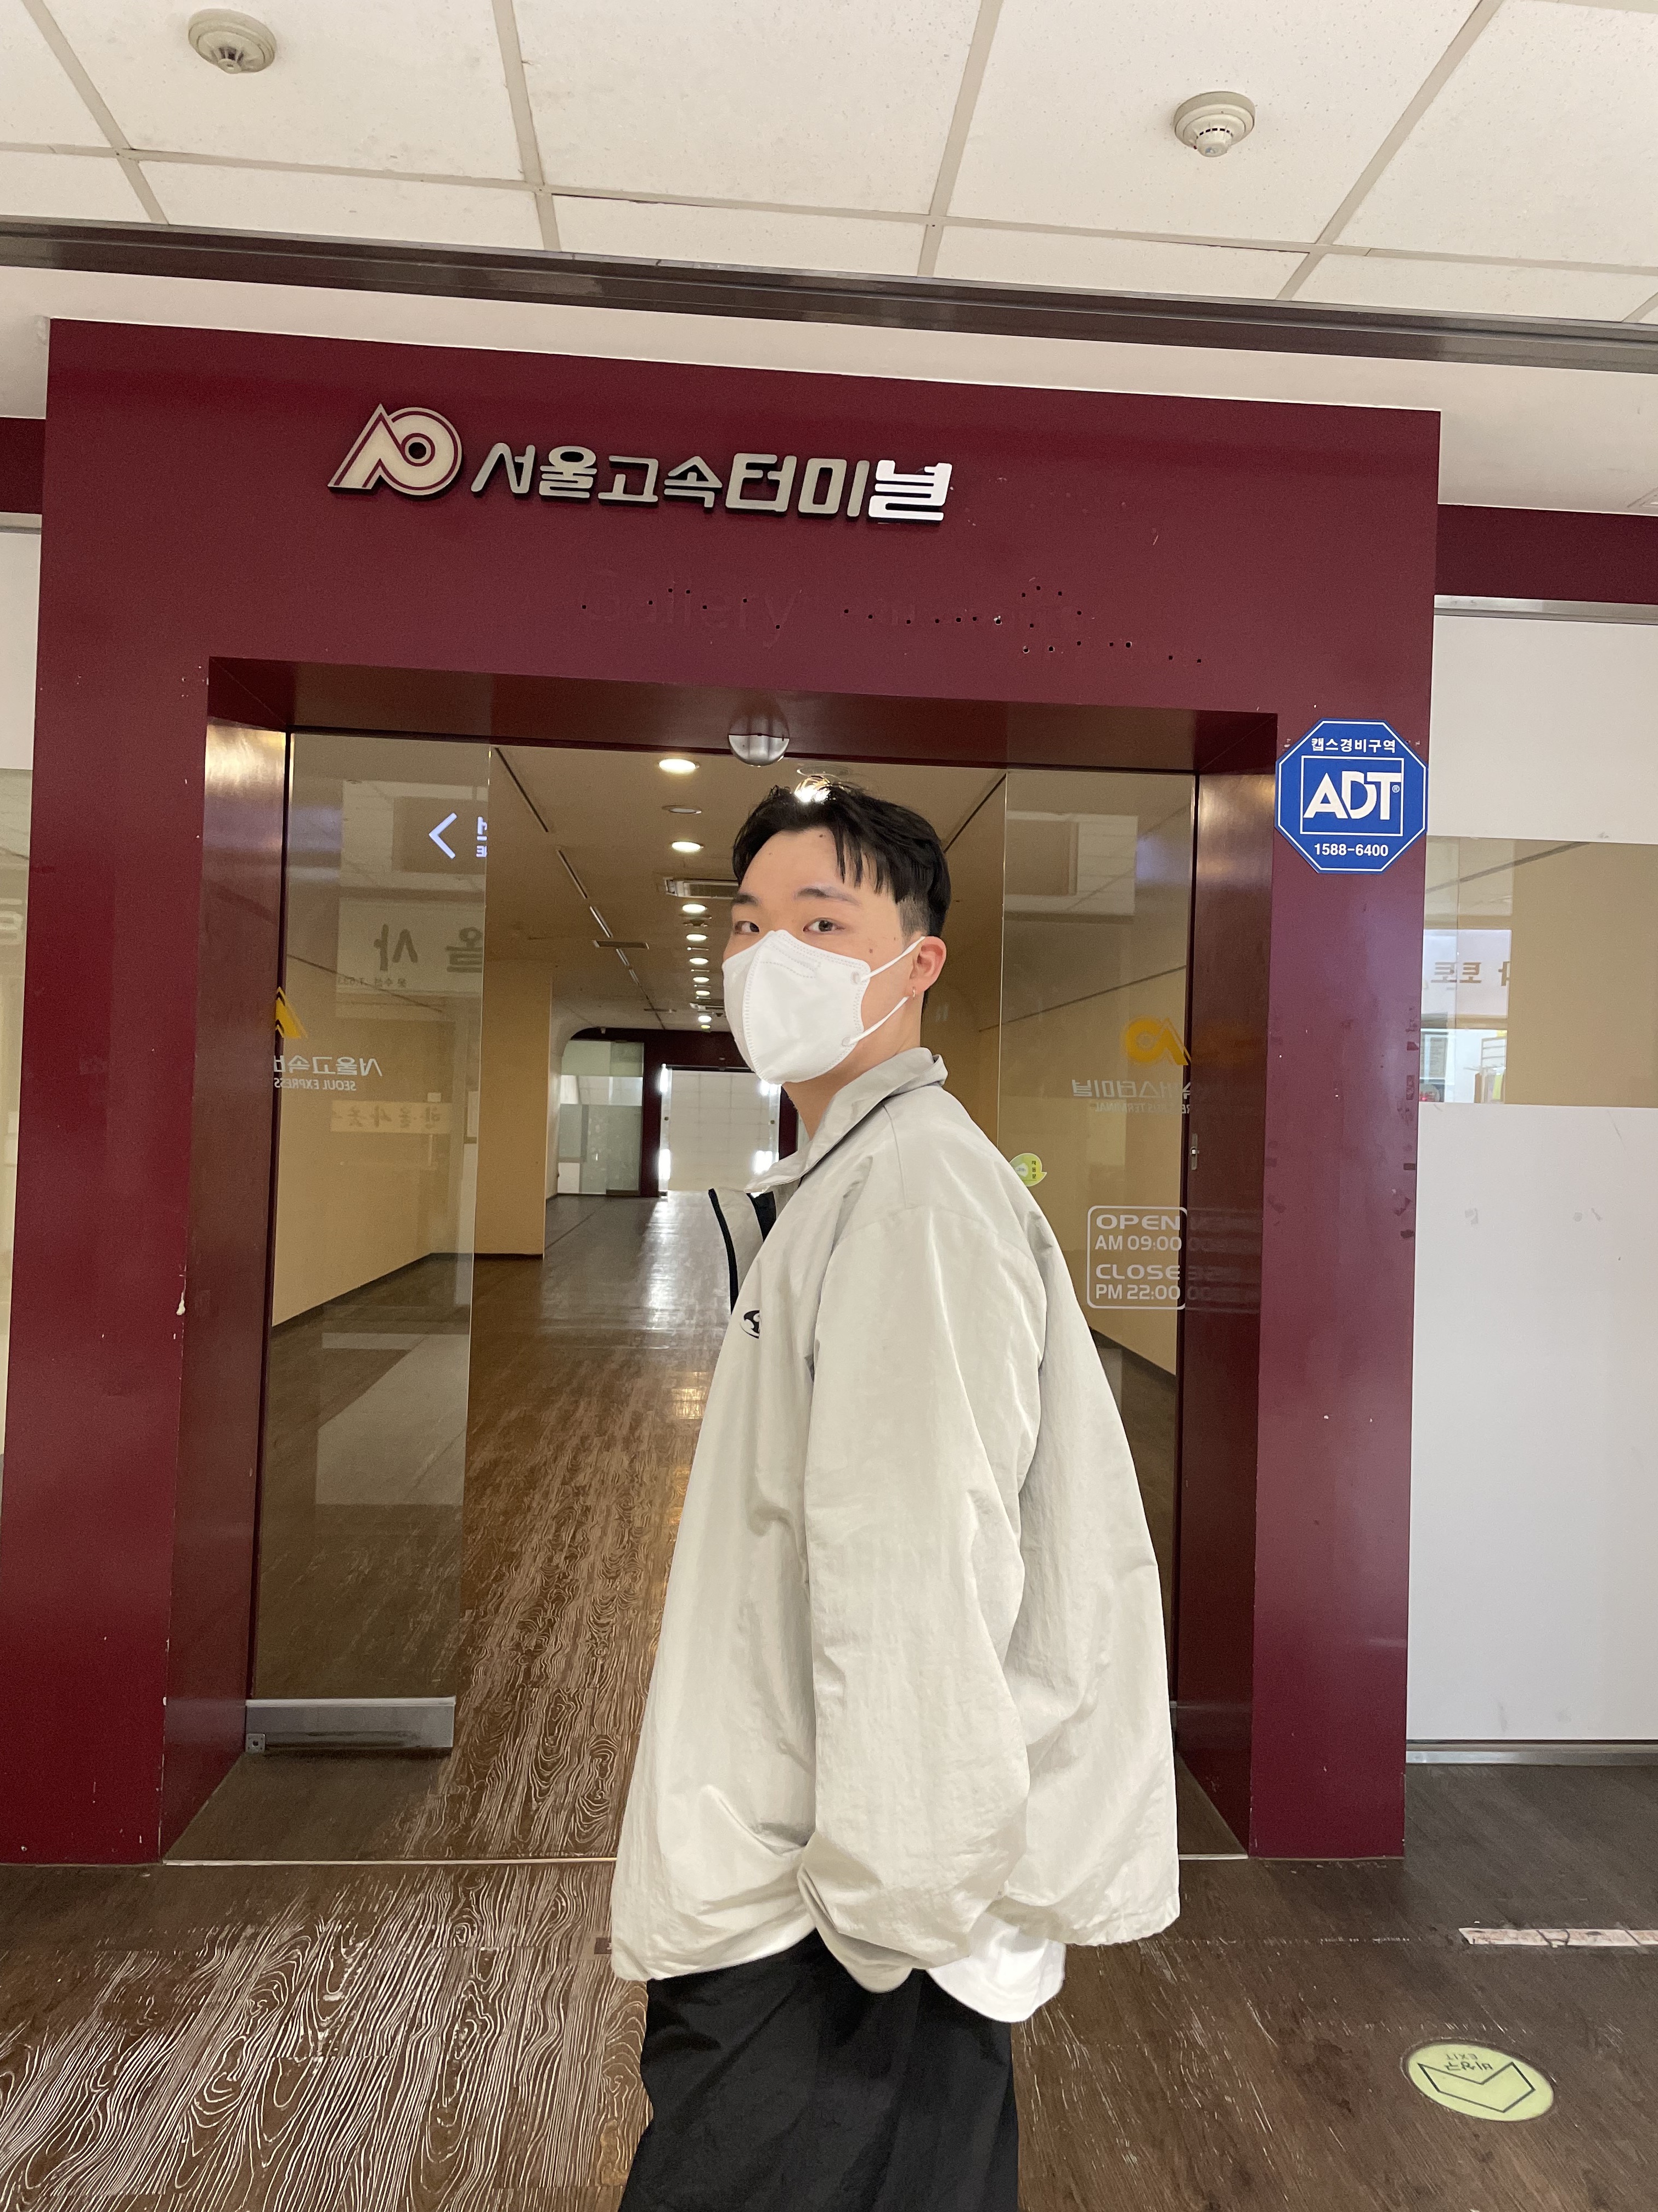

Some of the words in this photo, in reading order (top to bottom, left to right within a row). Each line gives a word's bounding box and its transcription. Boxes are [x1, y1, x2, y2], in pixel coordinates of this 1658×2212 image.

[471, 442, 953, 522] 서울고속터미널
[1311, 738, 1395, 753] 캡스경비구역
[1303, 771, 1402, 820] ADT
[1315, 843, 1388, 856] 1588-6400
[1096, 1214, 1180, 1230] OPEN
[1095, 1235, 1123, 1250] AM
[1127, 1235, 1182, 1251] 09:00
[1096, 1264, 1180, 1280] CLOSE
[1096, 1284, 1123, 1299] PM
[1127, 1284, 1180, 1300] 22:00
